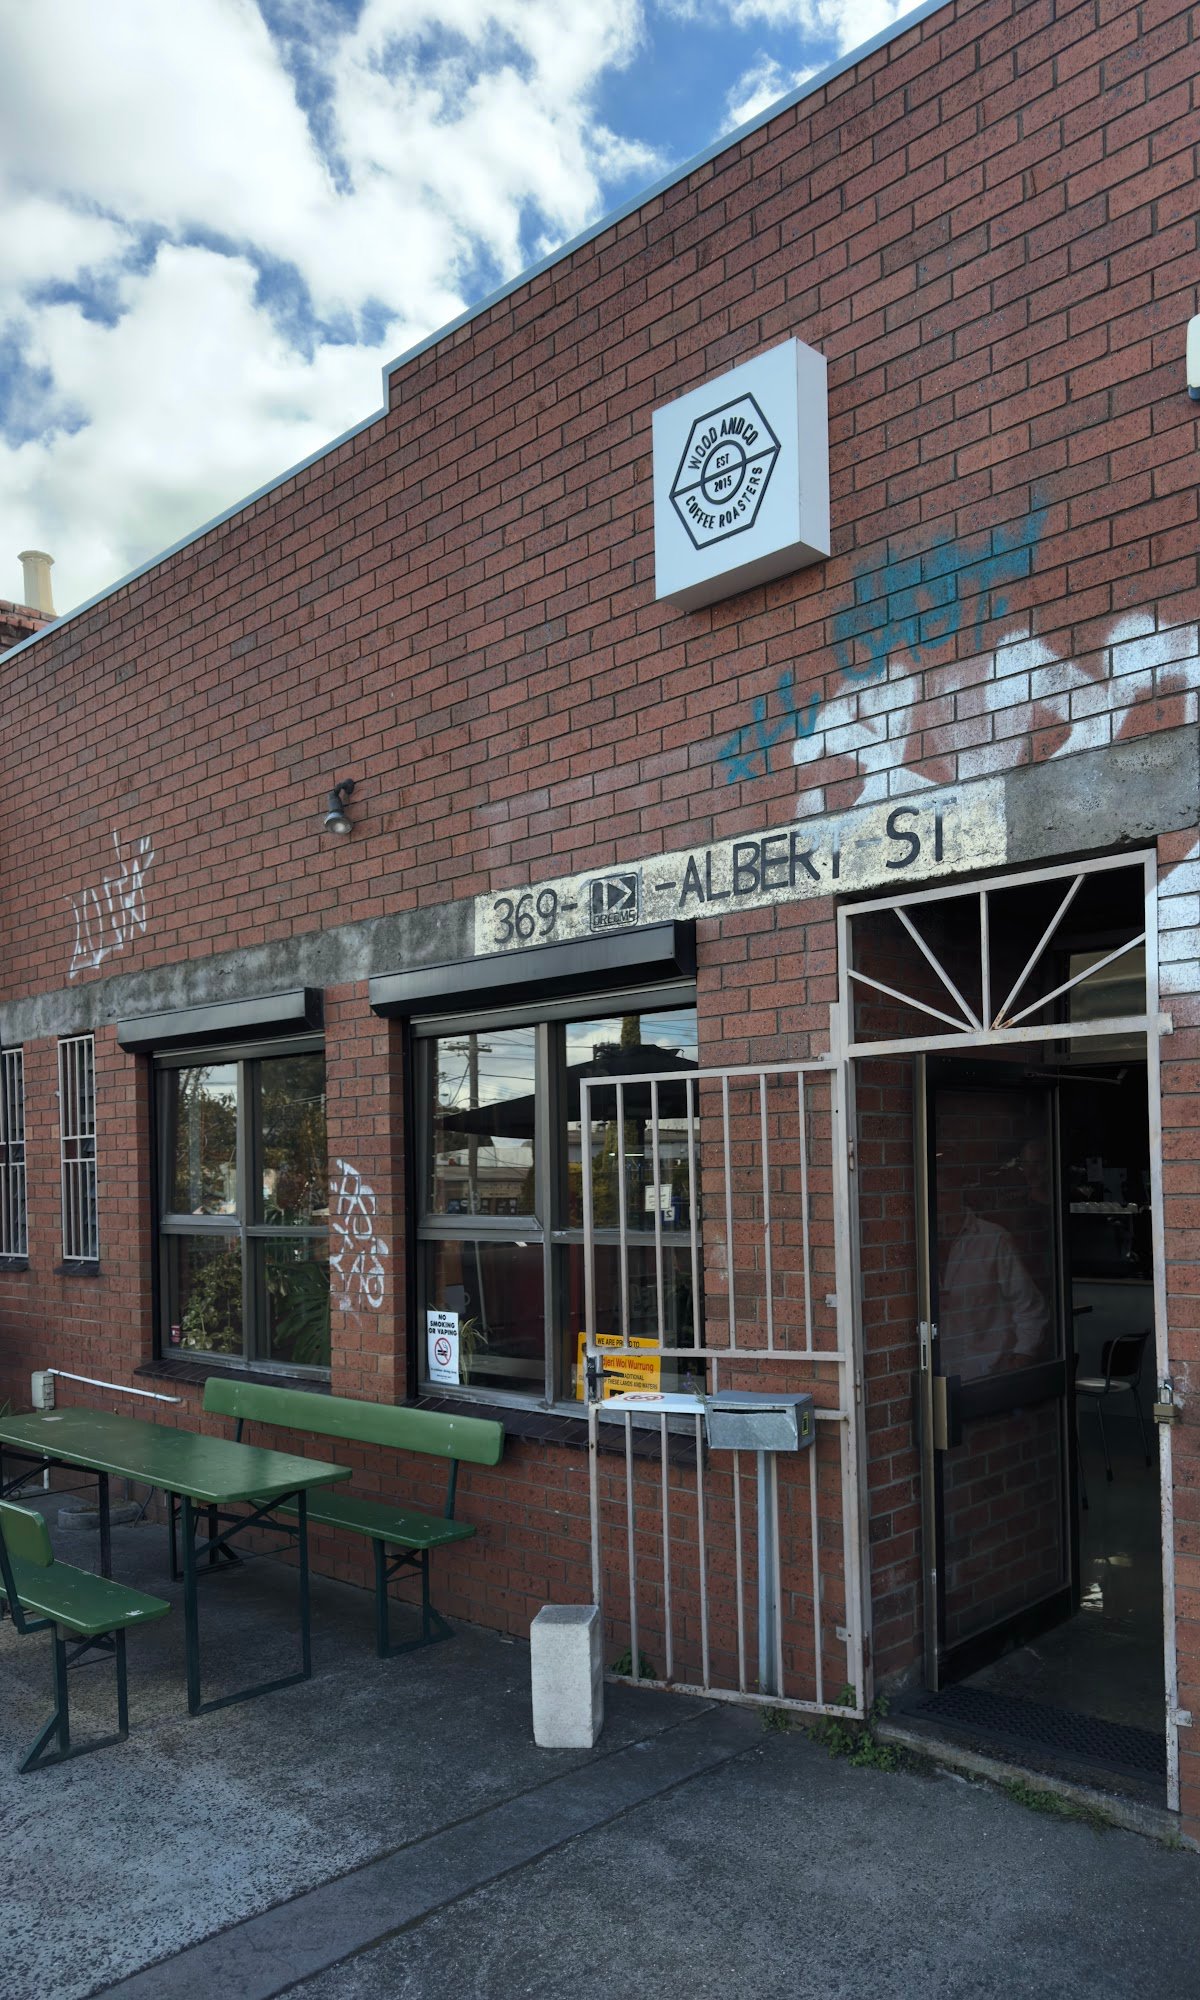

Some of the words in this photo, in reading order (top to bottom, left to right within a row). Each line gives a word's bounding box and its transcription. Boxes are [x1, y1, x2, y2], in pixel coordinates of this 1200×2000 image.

[688, 427, 718, 469] WOOD
[716, 452, 730, 468] EST
[714, 474, 732, 493] 2015
[685, 495, 716, 529] COFFEE
[719, 467, 763, 528] ROASTERS
[430, 1320, 455, 1329] SMOKING
[437, 1328, 458, 1337] VAPING
[633, 1341, 640, 1349] TO
[627, 1360, 654, 1374] Wurrung
